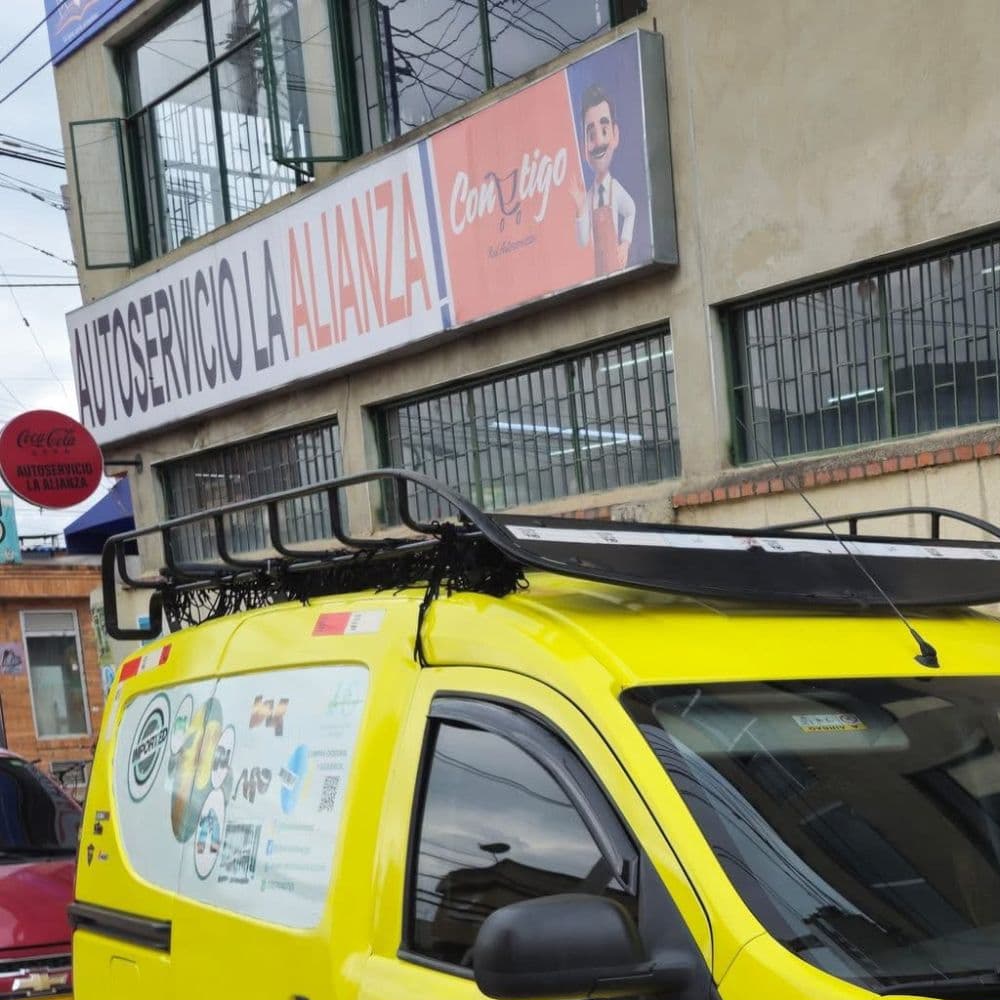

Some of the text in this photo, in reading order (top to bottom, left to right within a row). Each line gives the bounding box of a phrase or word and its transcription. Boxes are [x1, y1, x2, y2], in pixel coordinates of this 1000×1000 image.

[74, 172, 432, 428] AUTOSERVICIO LA ALIANZA
[17, 428, 76, 448] Coca-Cola
[17, 463, 93, 477] AUTOSERVICIO
[27, 477, 88, 491] LA ALIANZA
